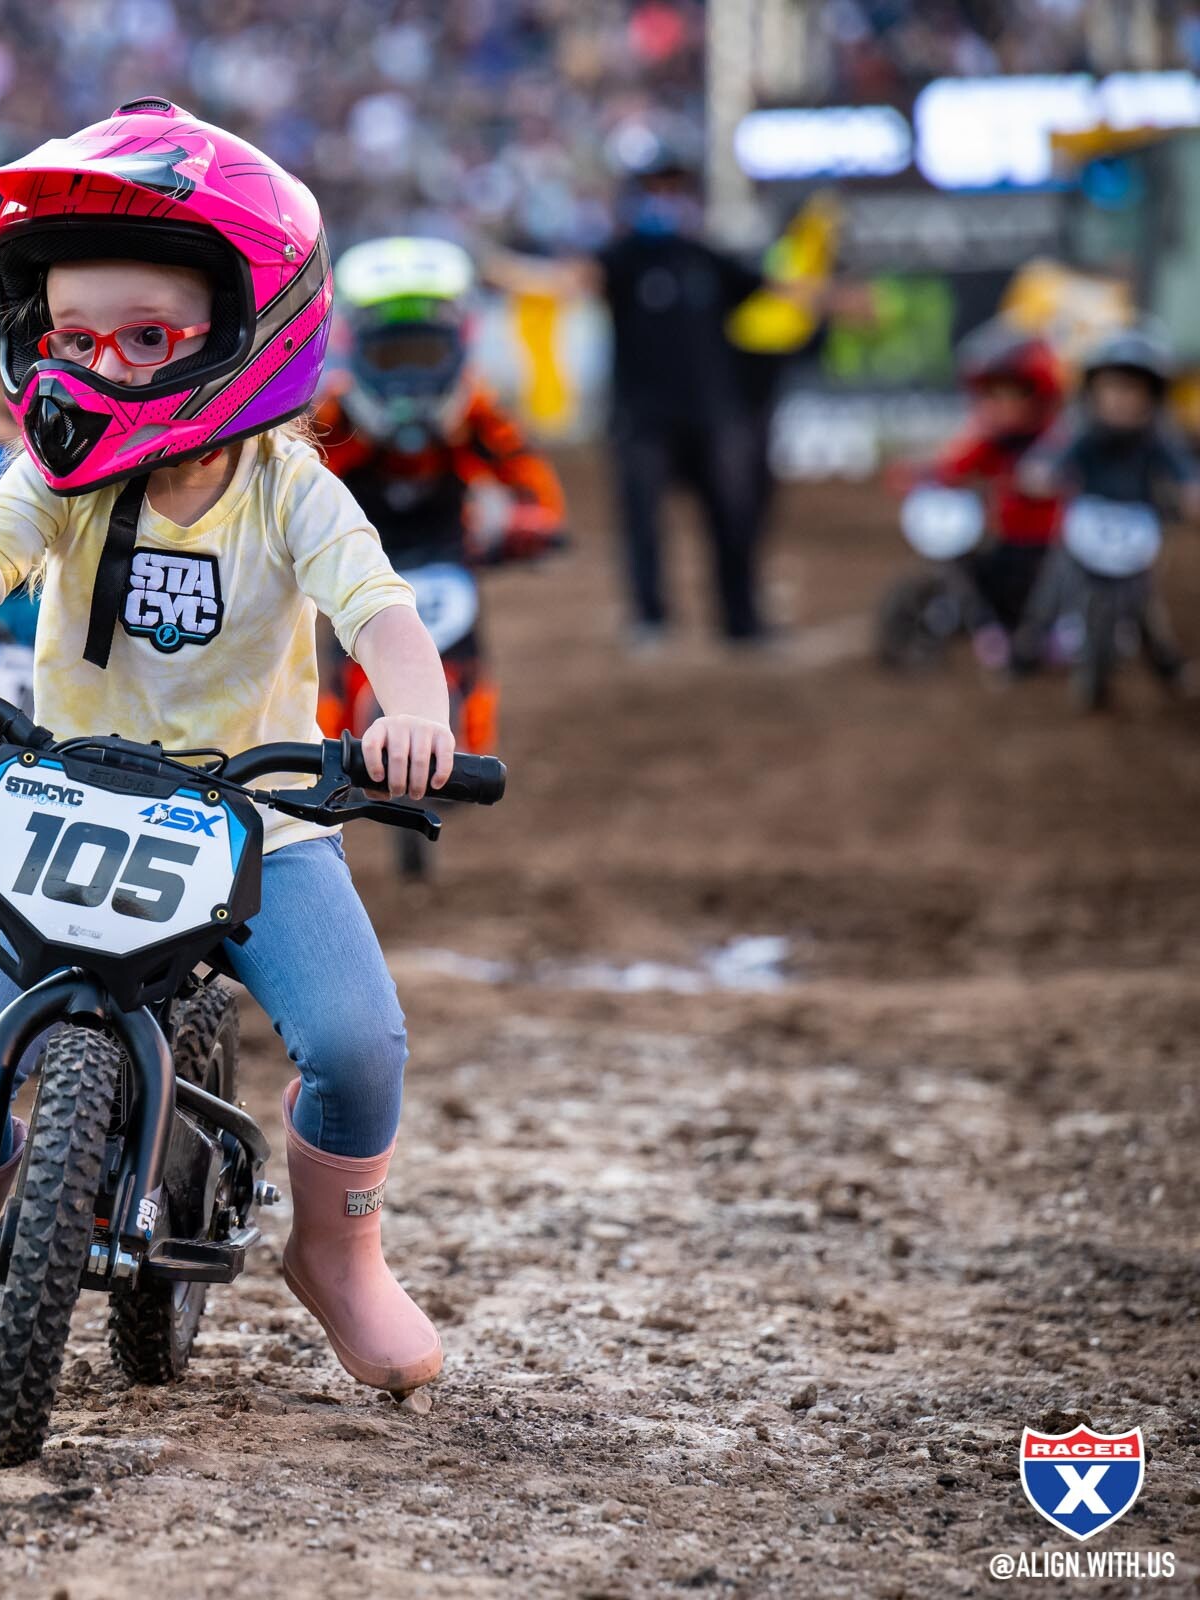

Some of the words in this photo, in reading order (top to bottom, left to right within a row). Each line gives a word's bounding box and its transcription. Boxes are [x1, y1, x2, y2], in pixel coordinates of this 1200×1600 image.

[129, 552, 216, 599] STA
[124, 589, 218, 633] CYC
[5, 776, 84, 806] STACYC
[12, 811, 200, 922] 105
